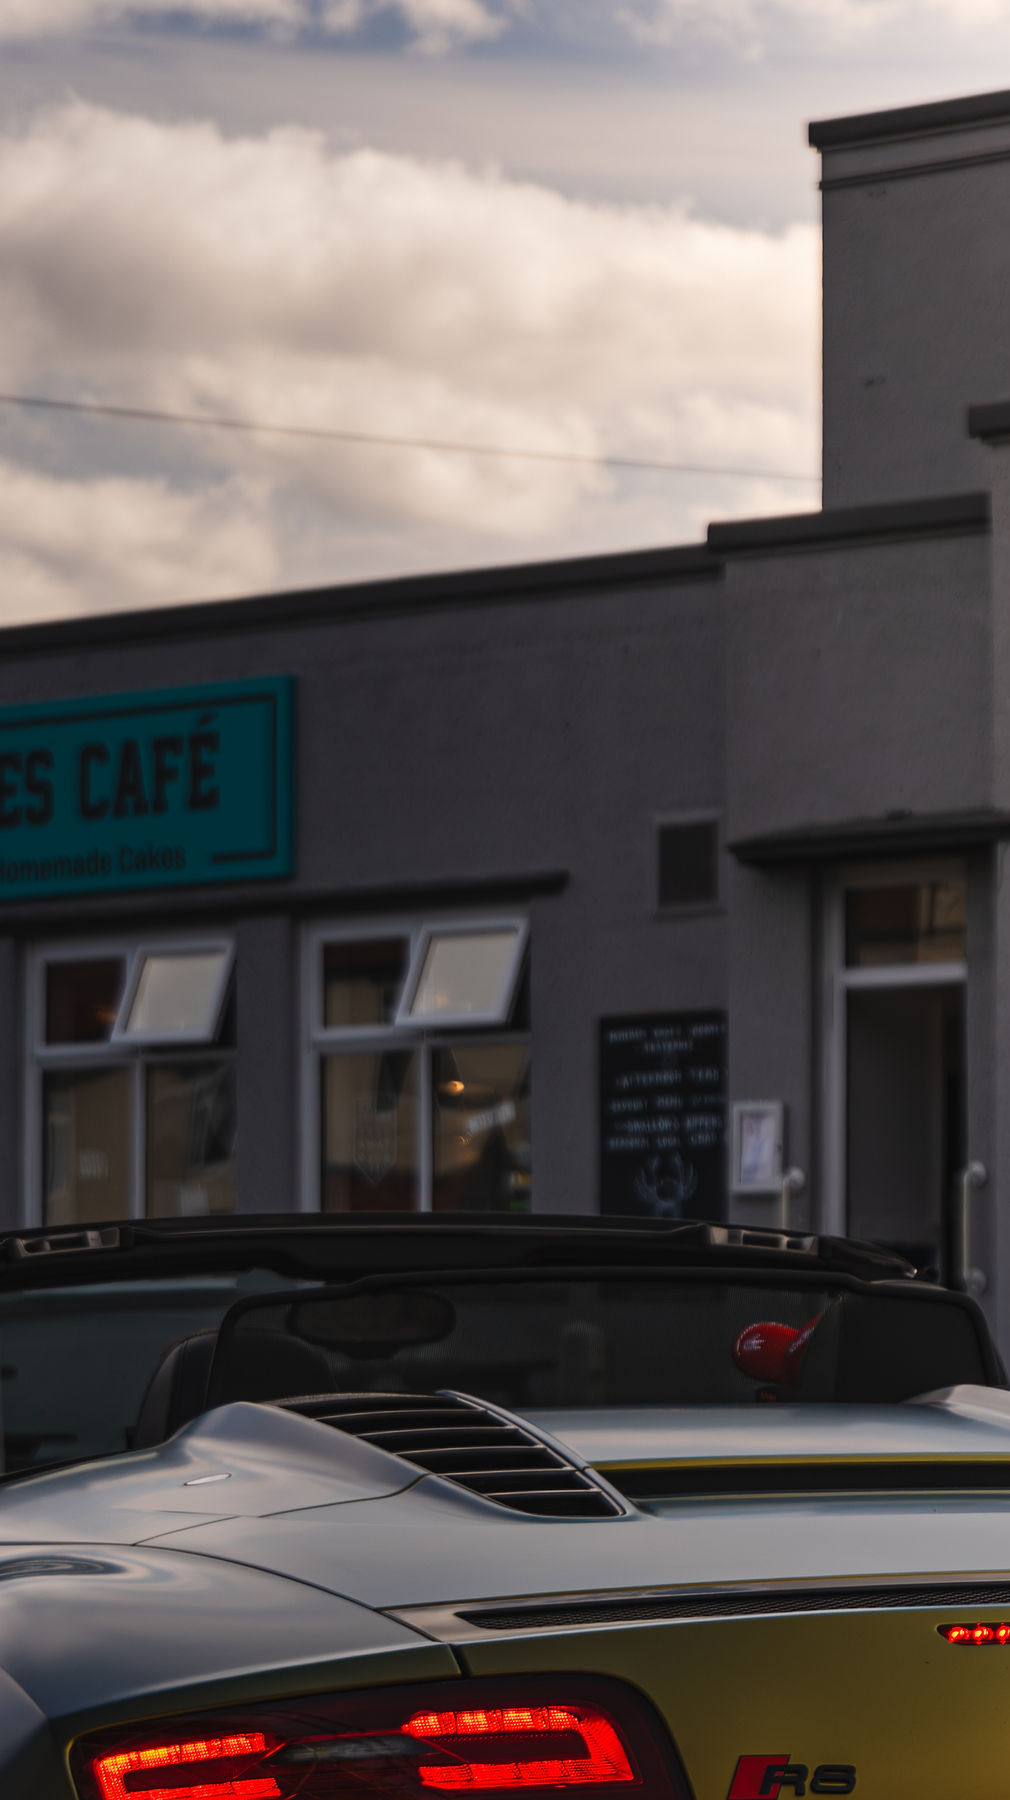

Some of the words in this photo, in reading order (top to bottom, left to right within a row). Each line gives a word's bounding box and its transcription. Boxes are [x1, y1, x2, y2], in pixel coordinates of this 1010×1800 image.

[0, 748, 54, 829] ES
[79, 714, 220, 821] CAFÉ
[120, 844, 186, 873] Cakes
[759, 1764, 856, 1796] R8
